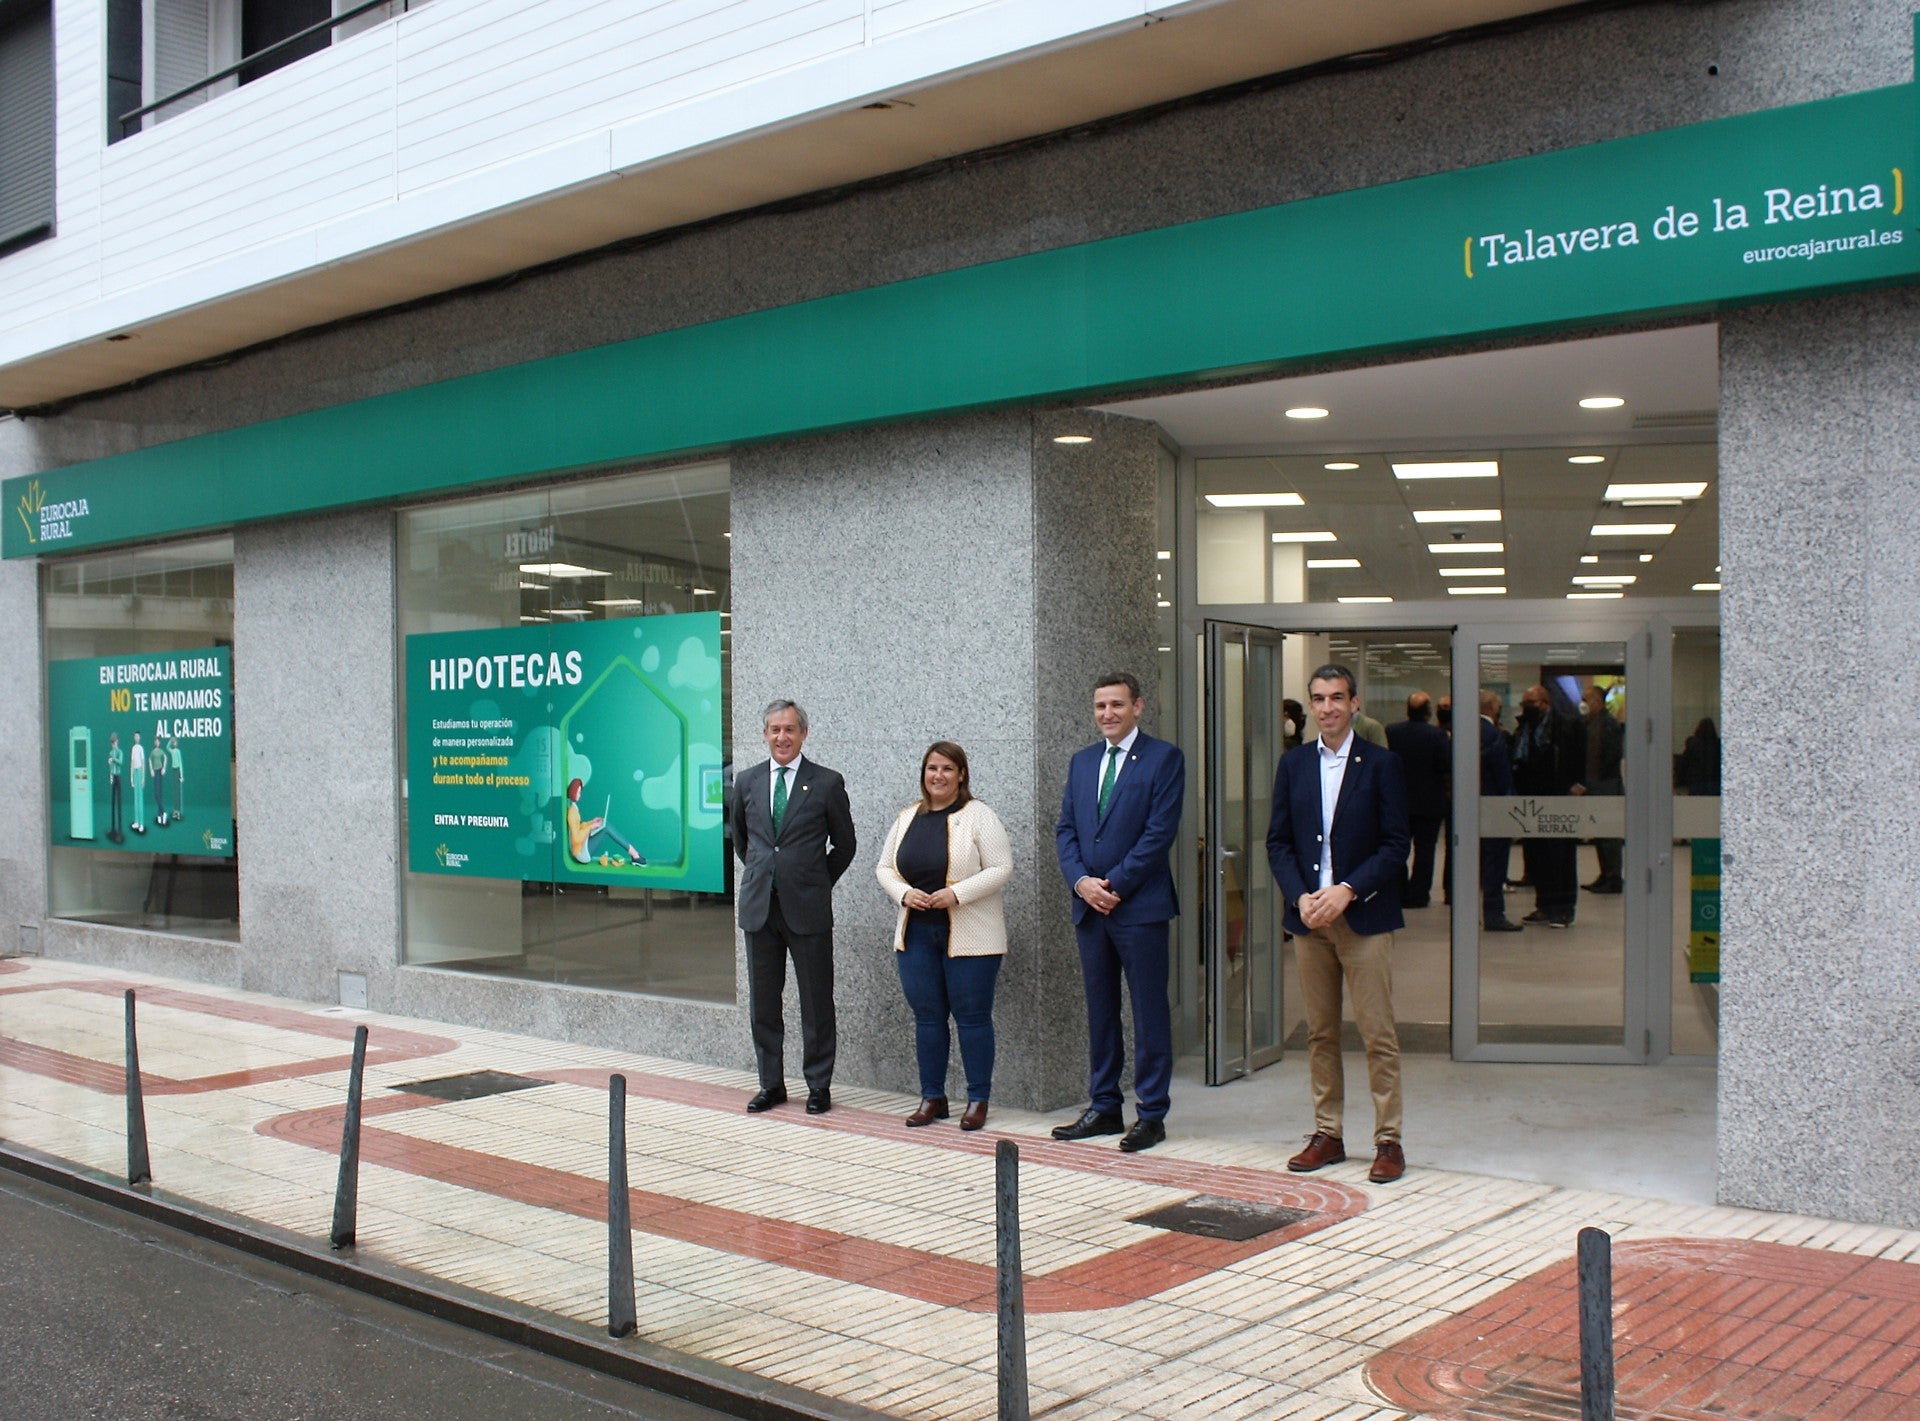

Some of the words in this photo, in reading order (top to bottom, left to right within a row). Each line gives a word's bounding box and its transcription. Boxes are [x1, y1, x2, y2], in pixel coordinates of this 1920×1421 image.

[1653, 205, 1699, 240] de
[1713, 198, 1749, 232] la
[1743, 229, 1904, 264] eurocajarural.es
[40, 498, 89, 523] EUROCAJA
[40, 520, 73, 541] RURAL
[99, 665, 115, 684] EN
[117, 661, 178, 684] EUROCAJA
[180, 657, 222, 679] RURAL
[430, 650, 583, 691] HIPOTECAS
[111, 688, 131, 712] NO
[134, 692, 148, 712] TE
[150, 688, 222, 711] MANDAMOS
[156, 719, 171, 738] AL
[173, 717, 222, 738] CAJERO
[432, 719, 470, 730] Estudiamos
[471, 719, 479, 729] tu
[479, 717, 513, 730] operación
[432, 737, 441, 747] de
[442, 738, 466, 747] manera
[467, 736, 514, 749] personalizada
[432, 756, 438, 768] y
[439, 755, 448, 766] te
[449, 753, 509, 768] acompañamos
[432, 772, 464, 785] durante
[465, 772, 484, 785] todo
[486, 773, 494, 785] el
[495, 775, 530, 788] proceso
[434, 814, 459, 826] ENTRA
[460, 815, 467, 826] Y
[467, 816, 509, 828] PREGUNTA
[1537, 824, 1576, 833] RURAL
